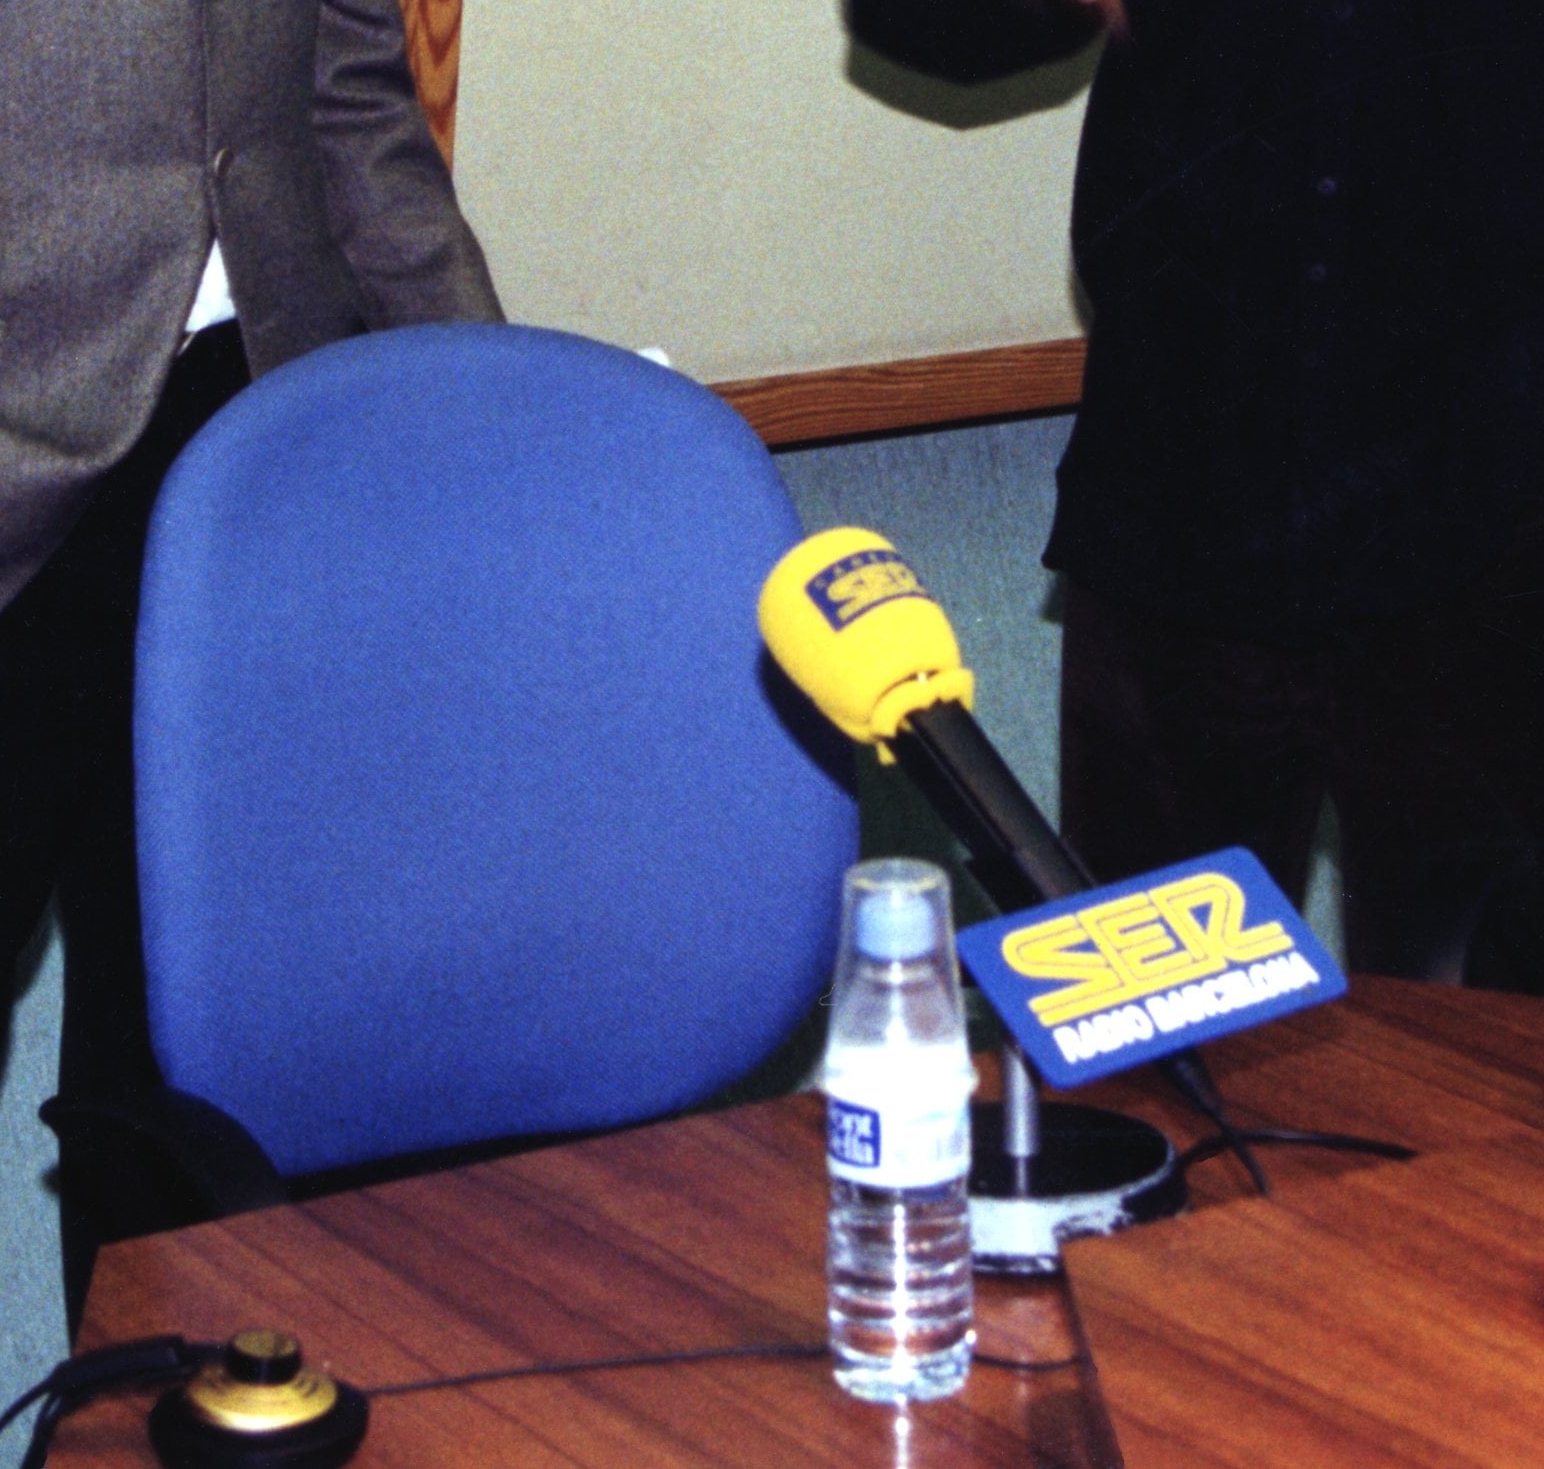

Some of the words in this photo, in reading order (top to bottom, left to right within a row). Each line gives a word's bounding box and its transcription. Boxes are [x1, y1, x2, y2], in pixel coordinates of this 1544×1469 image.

[1002, 872, 1294, 1027] SER
[1053, 1005, 1154, 1063] RADIO
[1146, 952, 1319, 1032] BARCELONA
